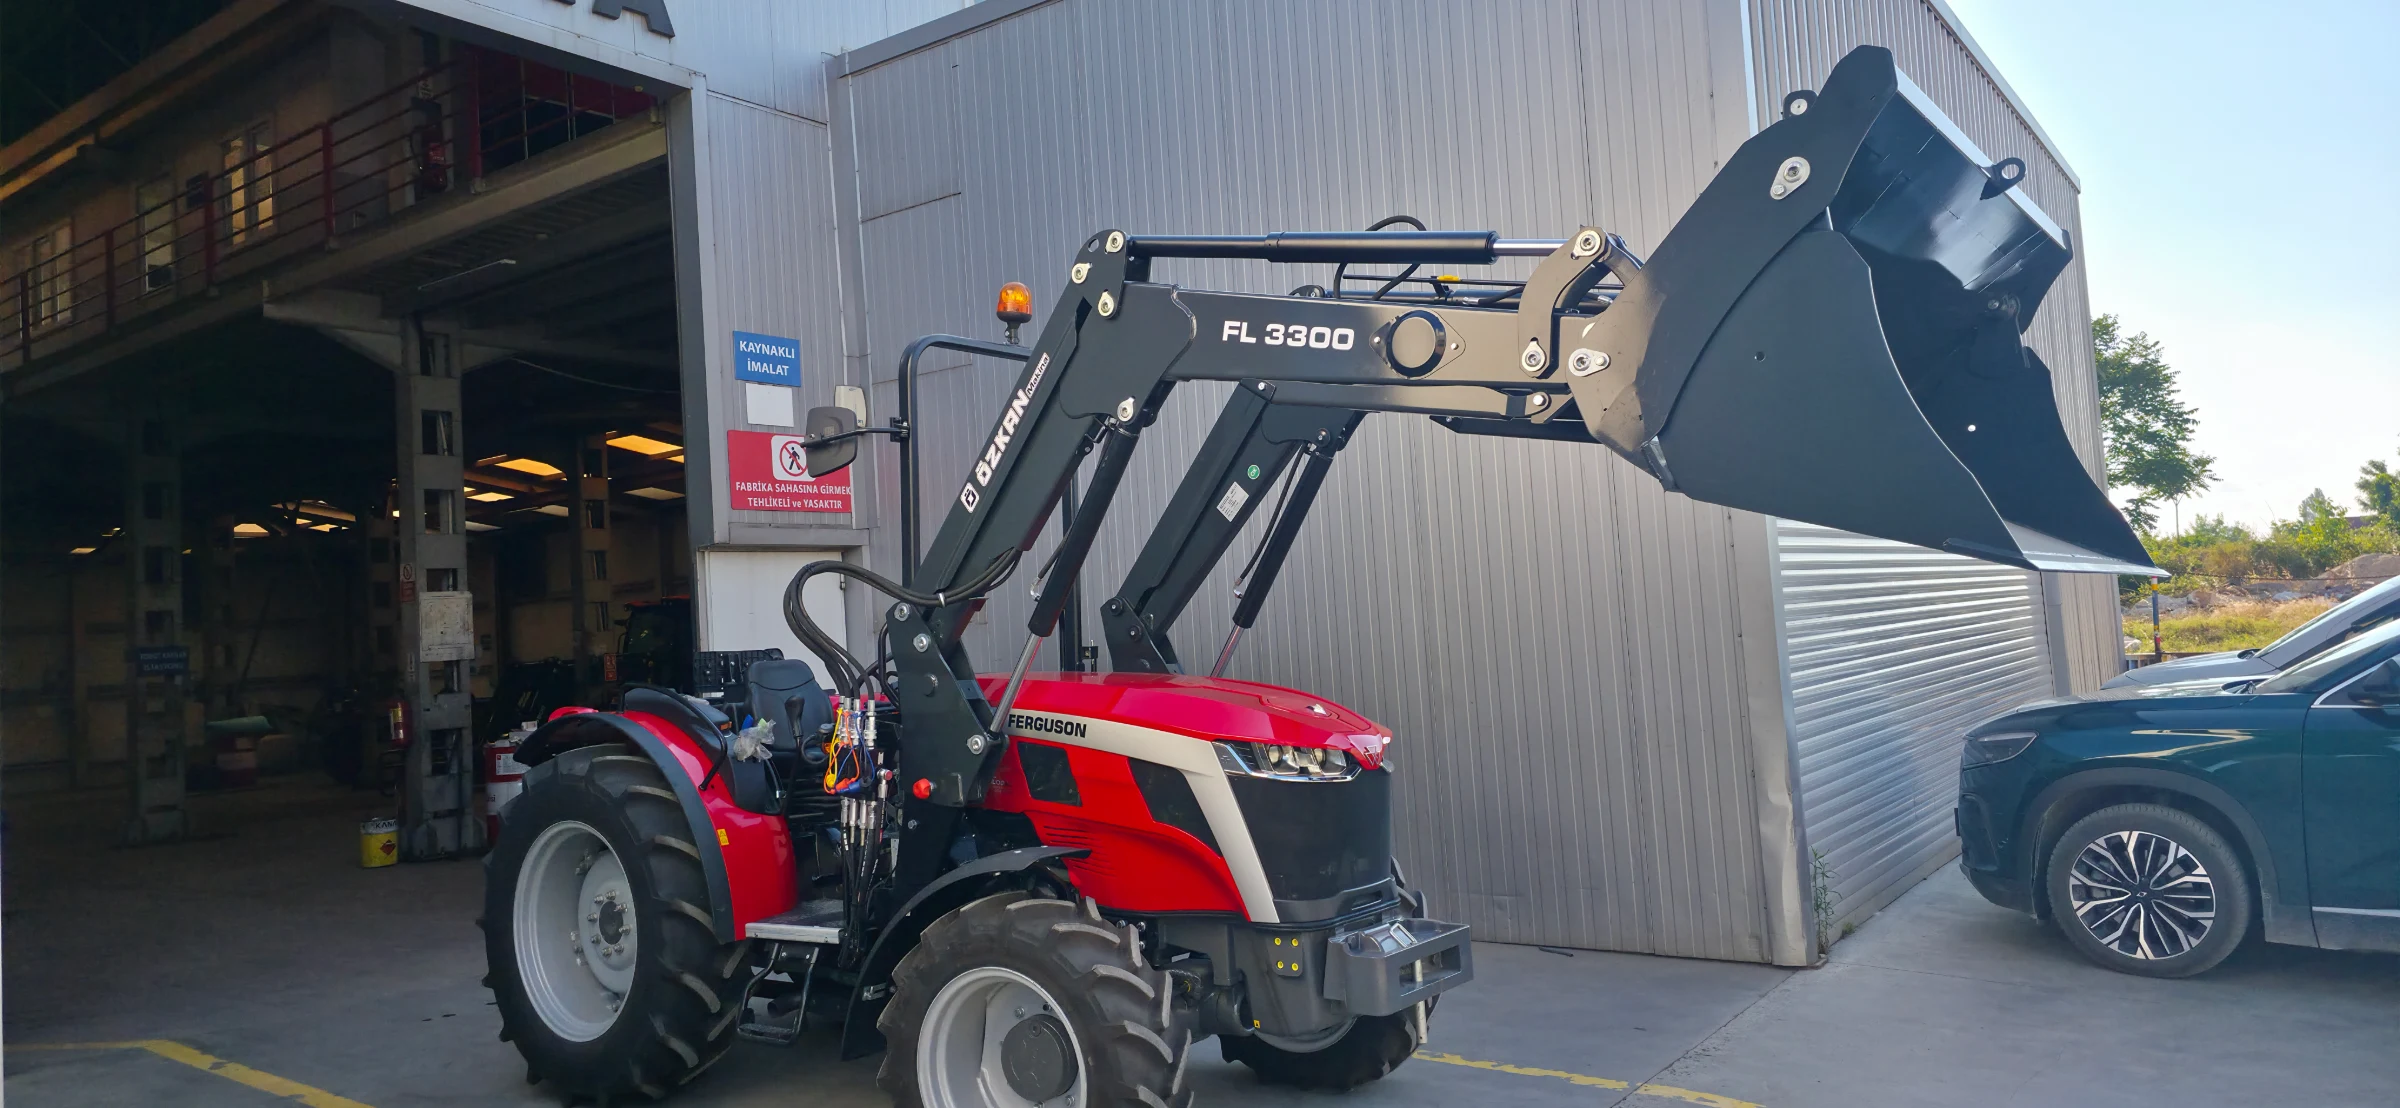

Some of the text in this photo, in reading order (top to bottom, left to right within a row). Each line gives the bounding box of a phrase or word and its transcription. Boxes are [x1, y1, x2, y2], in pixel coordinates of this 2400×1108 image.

[1222, 320, 1355, 351] FL 3300
[739, 340, 795, 359] KAYNAKLI
[747, 358, 789, 376] İMALAT
[975, 388, 1030, 487] ÖZKAN
[1027, 356, 1049, 395] Makina
[735, 480, 851, 495] FABRİKA SAHASINA GİRMEK
[747, 496, 843, 509] TEHLİKELİ ve YASAKTIR
[1007, 713, 1087, 739] FERGUSON
